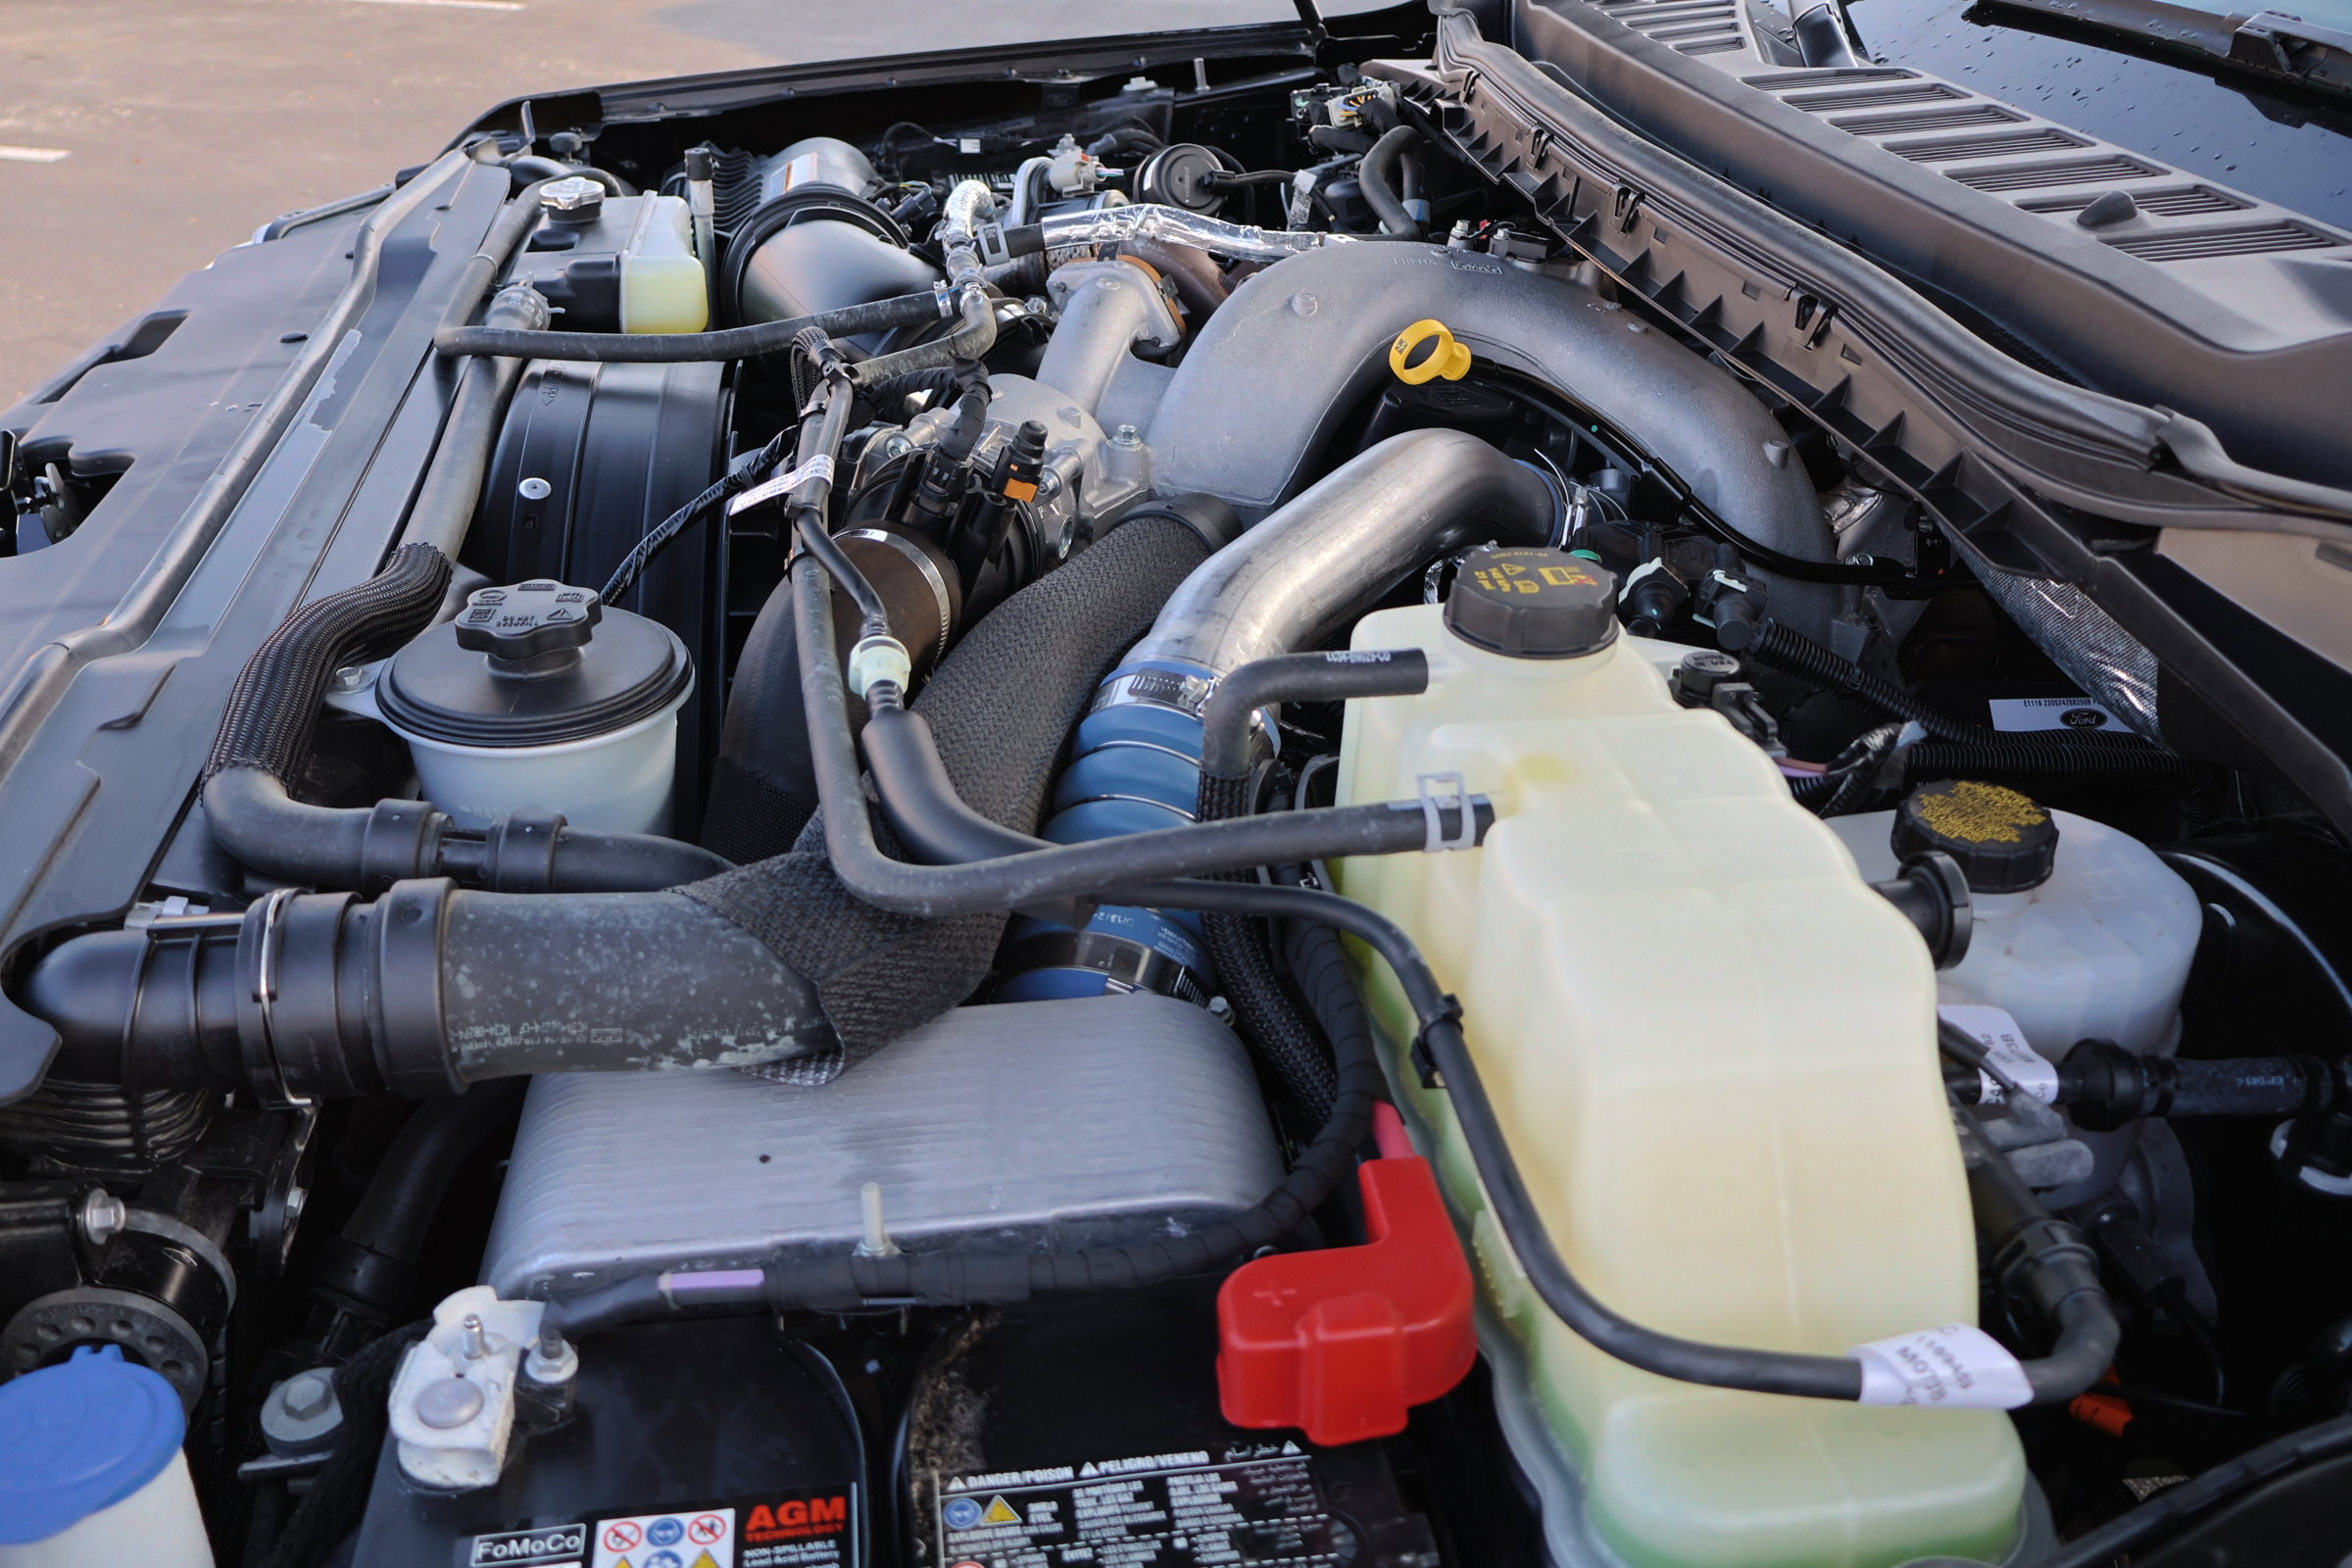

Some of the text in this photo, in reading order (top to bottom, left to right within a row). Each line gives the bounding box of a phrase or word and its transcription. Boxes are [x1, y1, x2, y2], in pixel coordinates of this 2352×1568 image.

[2069, 711, 2096, 725] Ford
[965, 1450, 1210, 1490] DANGER/POISON PELIGRO/VENENO
[745, 1495, 847, 1533] AGM
[745, 1523, 845, 1544] TECHNOLOGY
[477, 1533, 581, 1561] FoMoCo
[743, 1539, 837, 1559] NON-SPILLABLE
